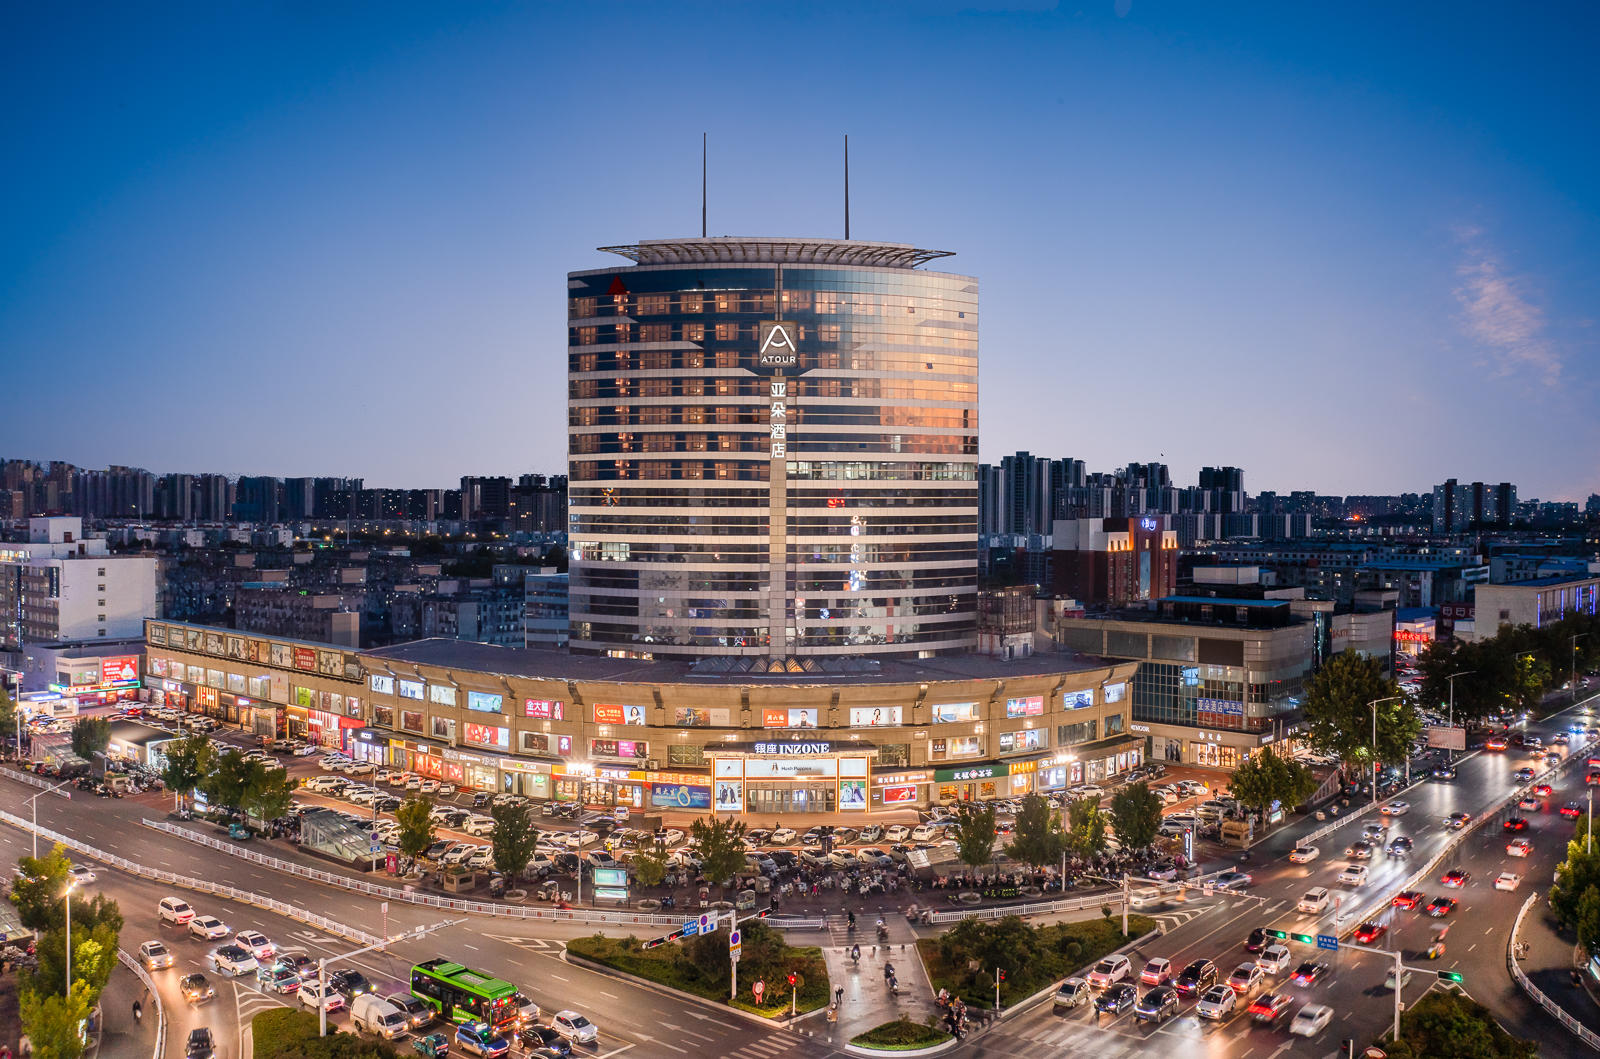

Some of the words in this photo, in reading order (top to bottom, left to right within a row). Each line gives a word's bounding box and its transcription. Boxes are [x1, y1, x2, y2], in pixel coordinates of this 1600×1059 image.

[761, 355, 796, 364] ATOUR
[771, 383, 785, 458] 亚朵酒店
[754, 743, 777, 754] 银座
[779, 743, 830, 754] INZONE
